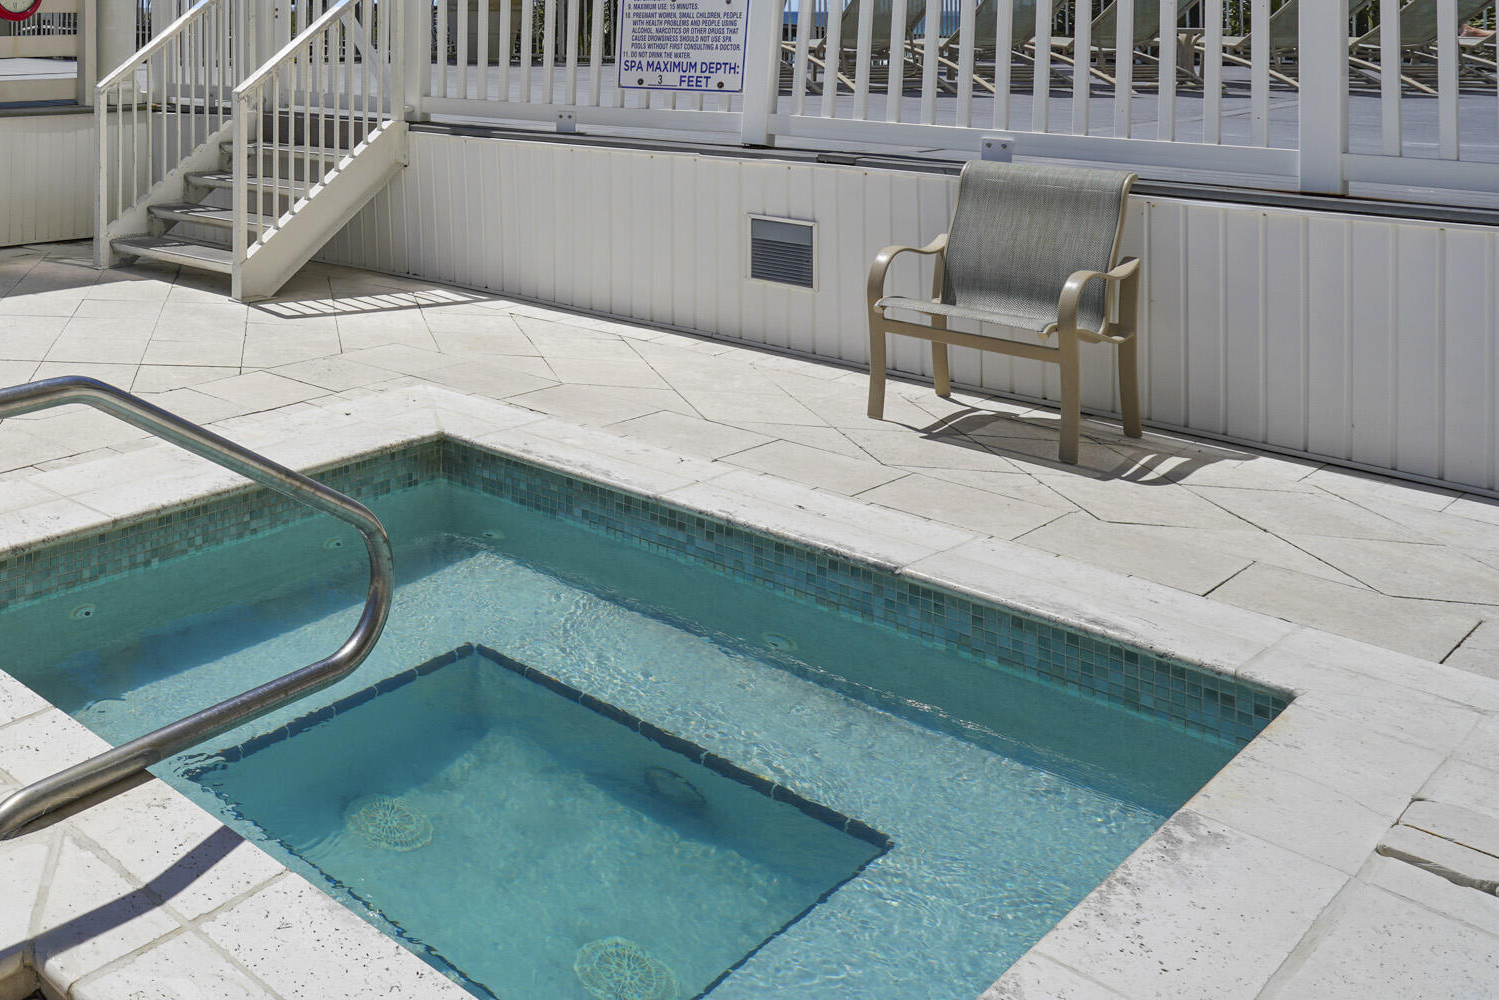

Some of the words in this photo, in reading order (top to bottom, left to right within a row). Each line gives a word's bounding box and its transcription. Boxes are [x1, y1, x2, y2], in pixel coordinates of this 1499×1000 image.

[624, 60, 643, 72] SPA
[646, 61, 697, 73] MAXIMUM
[700, 62, 740, 74] DEPTH:
[658, 75, 662, 84] 3
[679, 76, 711, 88] FEET
